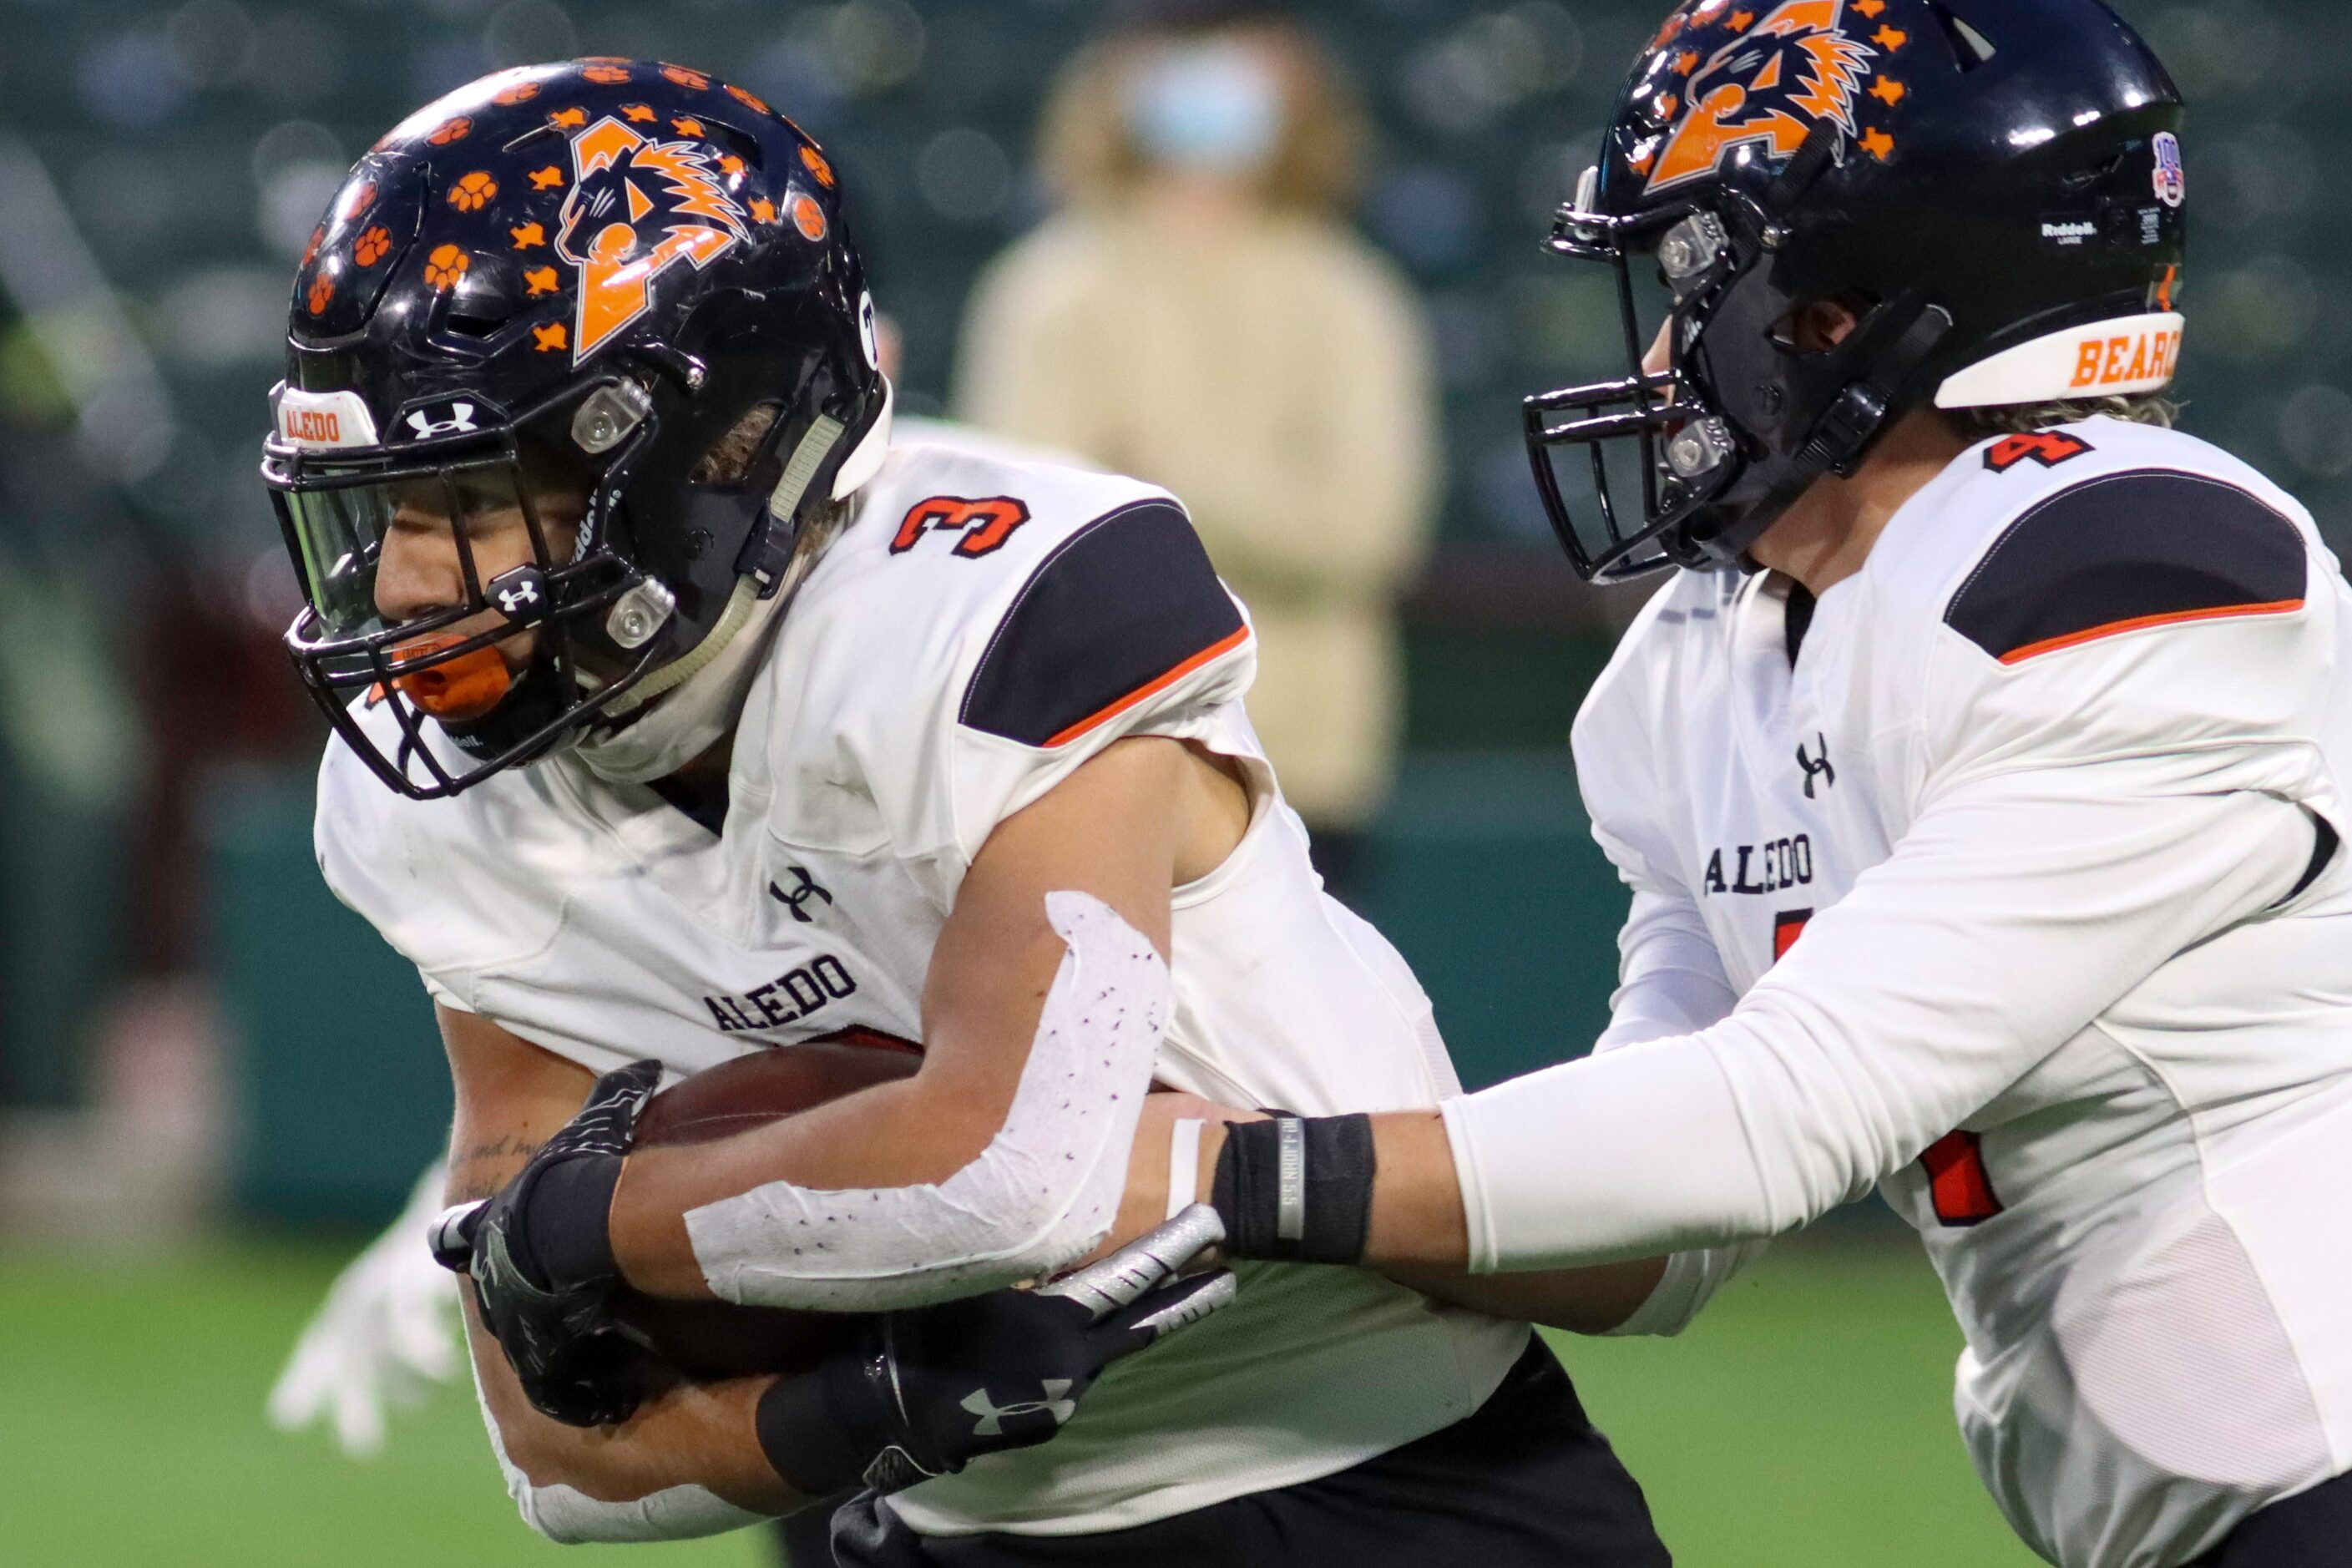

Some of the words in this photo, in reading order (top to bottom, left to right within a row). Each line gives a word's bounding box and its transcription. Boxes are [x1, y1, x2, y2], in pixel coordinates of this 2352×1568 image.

[286, 410, 340, 443] ALEDO
[1982, 429, 2097, 474] 4
[888, 495, 1031, 559] 3
[1704, 833, 1813, 897] ALEDO
[703, 953, 857, 1031] ALEDO
